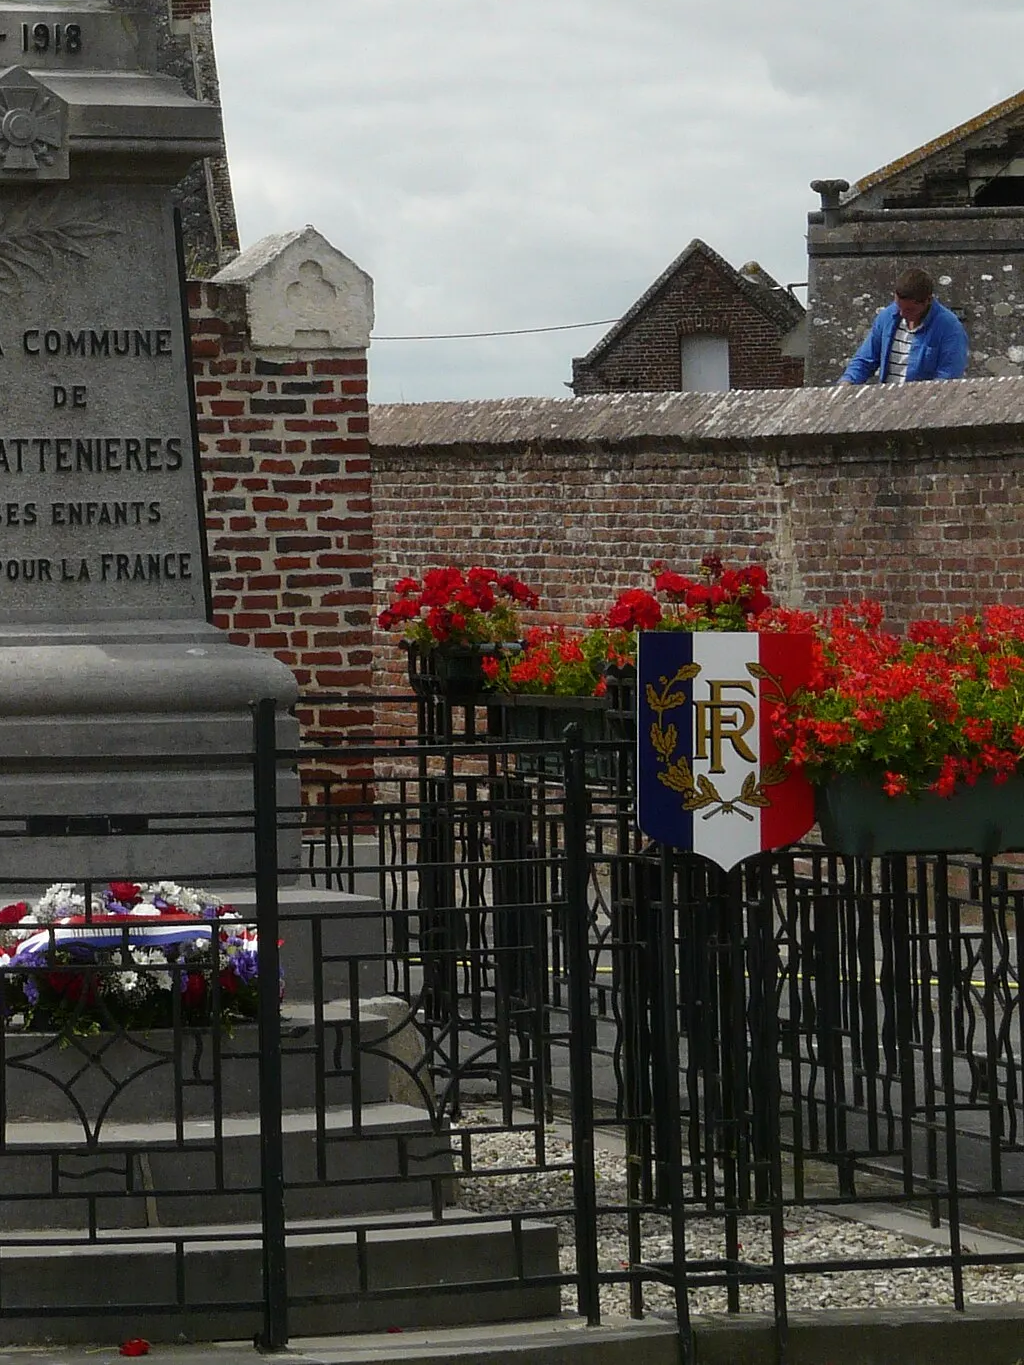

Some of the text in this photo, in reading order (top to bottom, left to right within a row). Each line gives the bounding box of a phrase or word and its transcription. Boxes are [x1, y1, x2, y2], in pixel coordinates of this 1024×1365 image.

[21, 21, 83, 54] 1918
[23, 329, 172, 357] COMMUNE
[53, 385, 87, 409] DE
[51, 501, 161, 526] ENFANTS
[61, 558, 90, 582] LA
[101, 553, 192, 582] FRANCE
